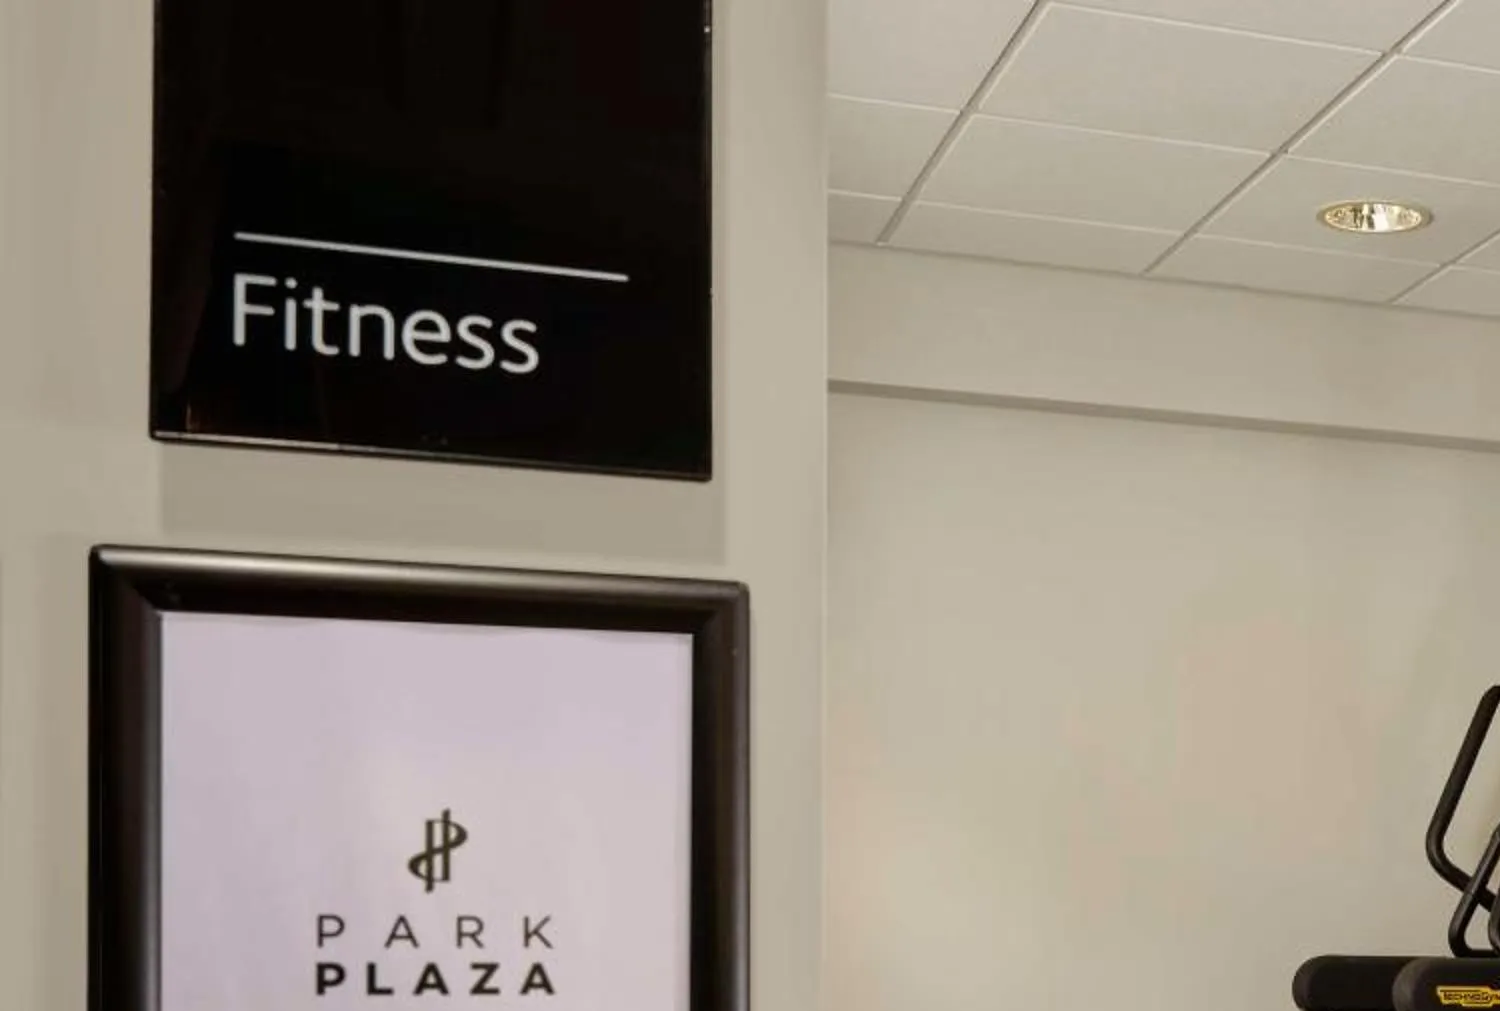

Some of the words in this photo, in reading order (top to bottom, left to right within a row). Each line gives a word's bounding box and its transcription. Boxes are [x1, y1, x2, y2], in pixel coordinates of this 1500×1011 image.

[232, 272, 541, 375] Fitness
[316, 914, 553, 949] PARK
[315, 962, 555, 996] PLAZA
